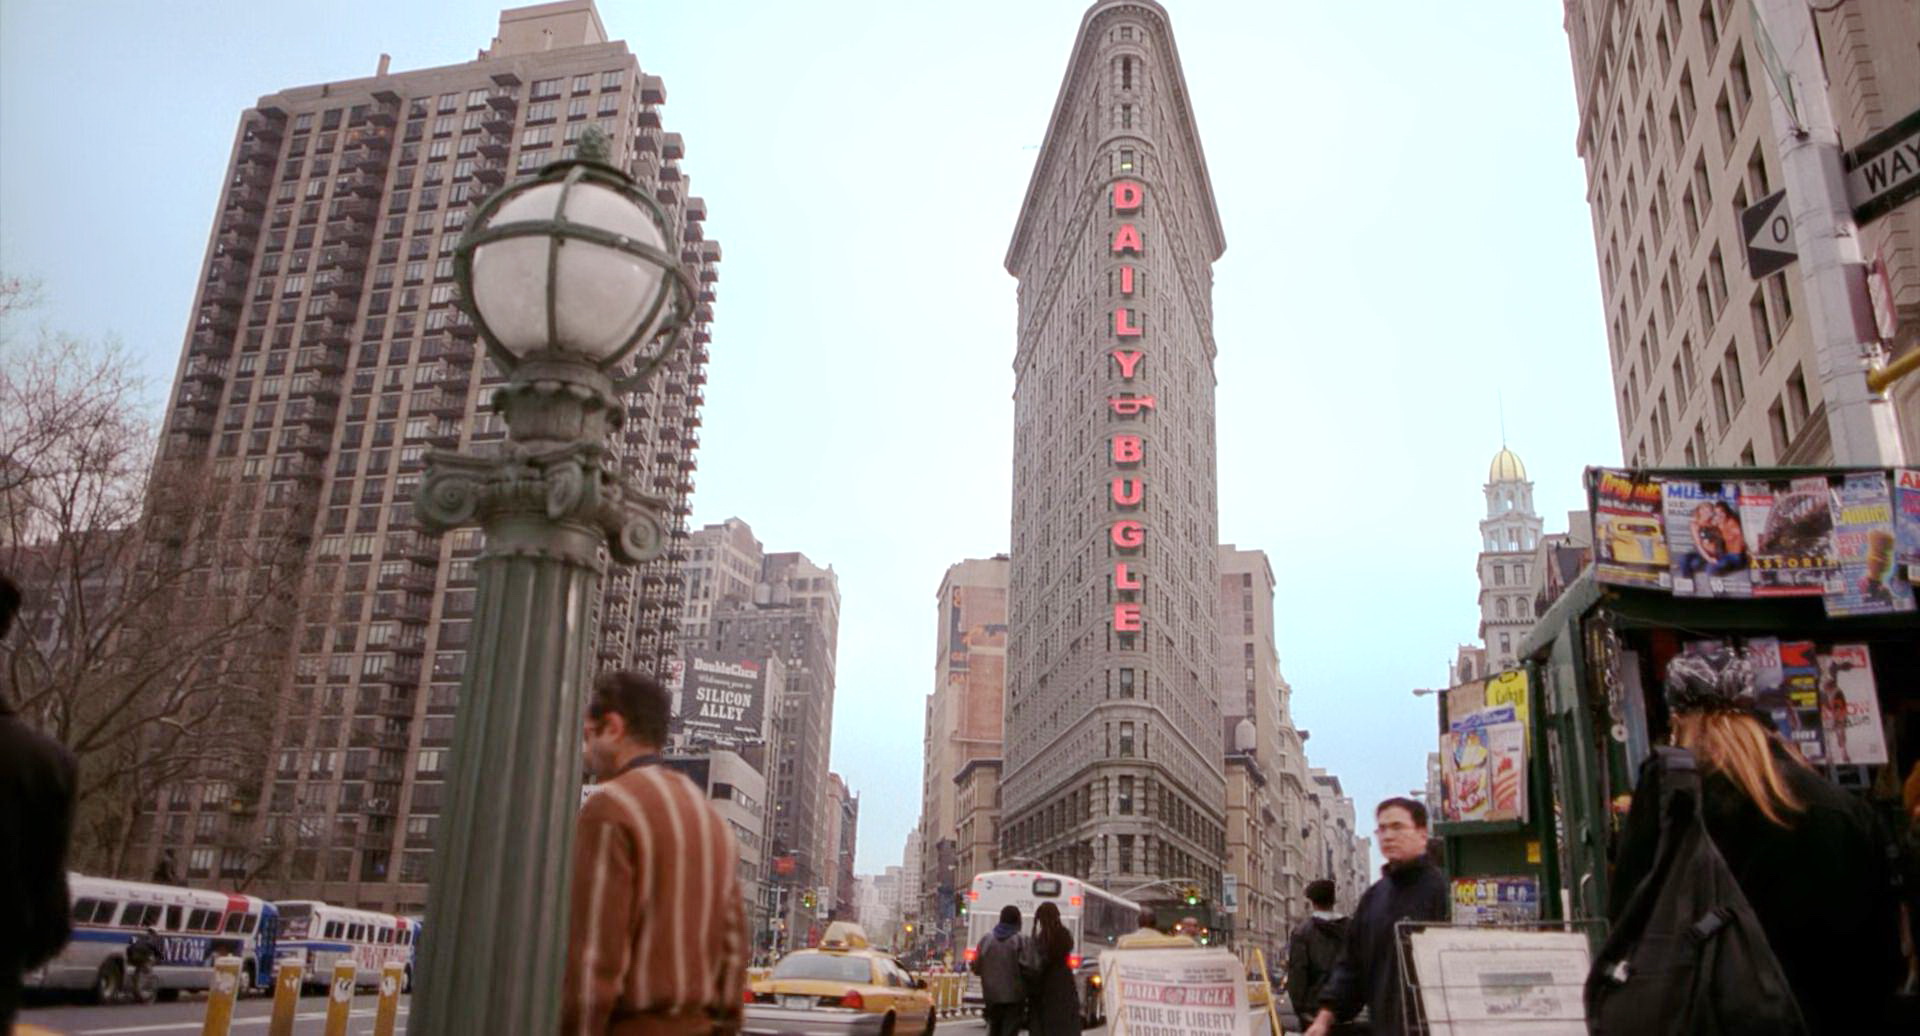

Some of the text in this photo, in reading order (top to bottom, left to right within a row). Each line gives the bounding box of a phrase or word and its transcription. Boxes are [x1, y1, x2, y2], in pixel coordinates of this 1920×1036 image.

[1111, 181, 1145, 633] DAILY BUGLE
[695, 686, 752, 708] SILICON
[700, 702, 744, 722] ALLEY
[1123, 983, 1231, 1005] DAILY BUGLE
[1126, 1004, 1237, 1031] TATUE OF LIBERTY
